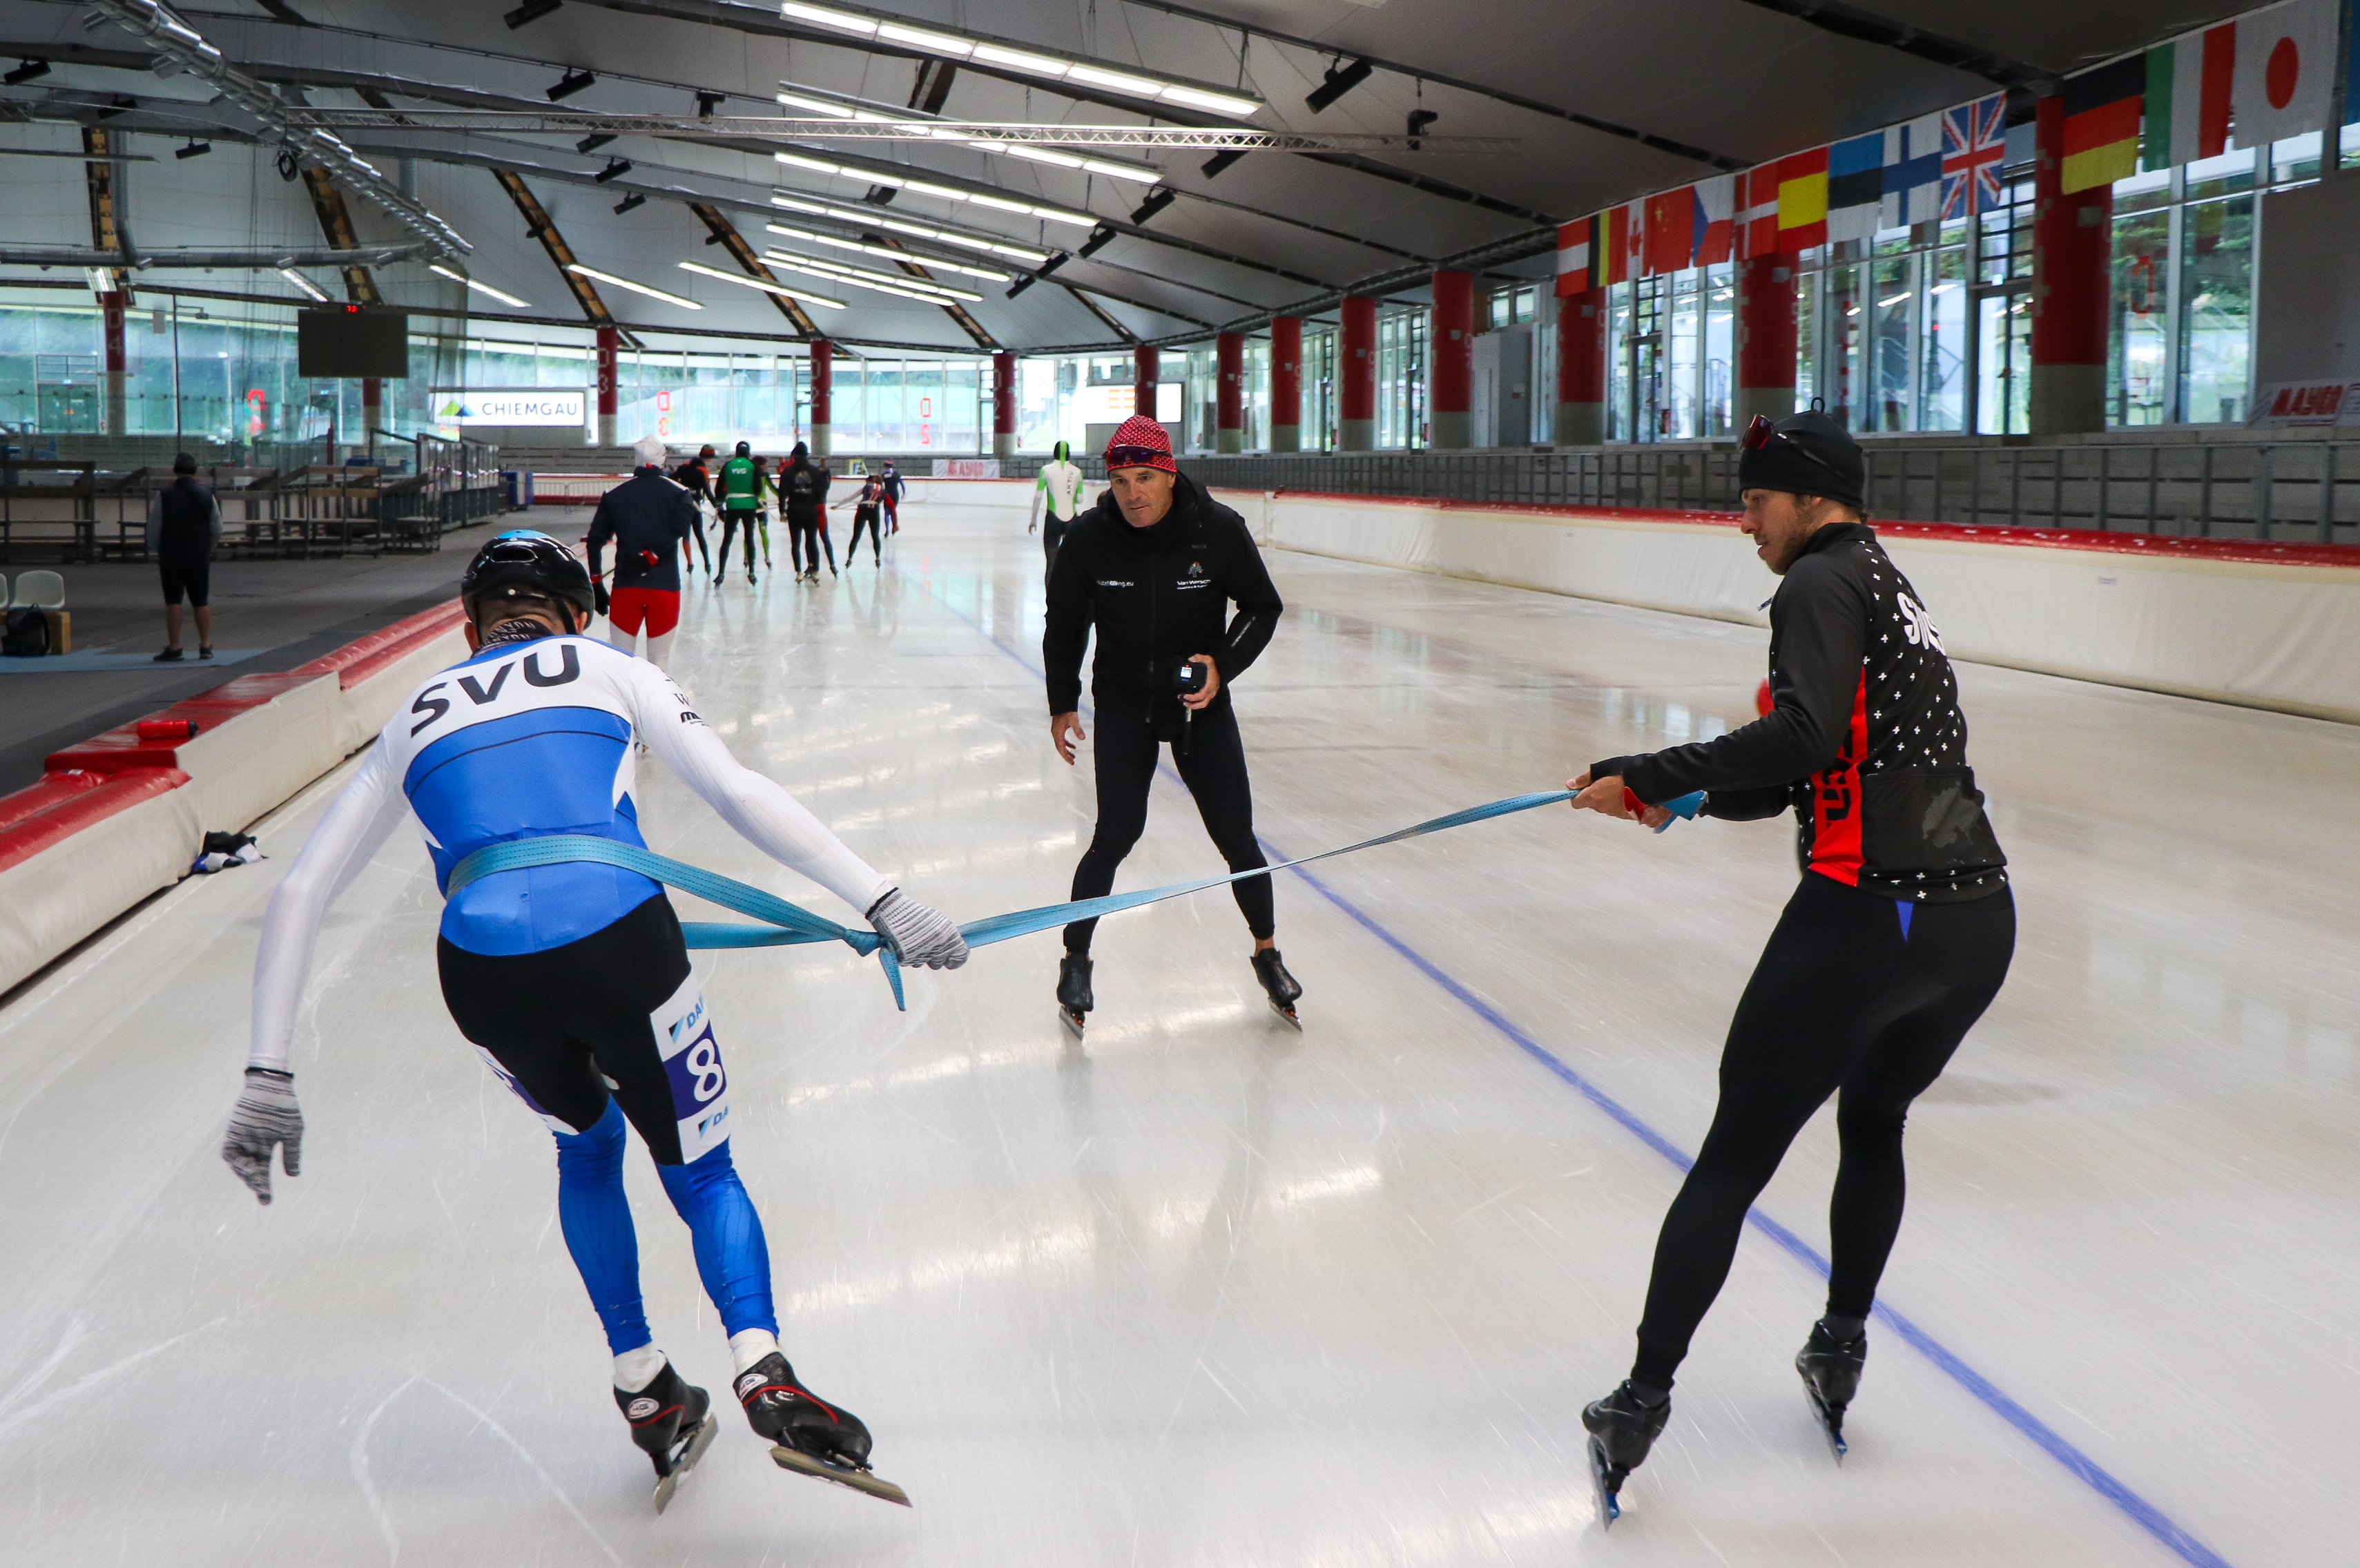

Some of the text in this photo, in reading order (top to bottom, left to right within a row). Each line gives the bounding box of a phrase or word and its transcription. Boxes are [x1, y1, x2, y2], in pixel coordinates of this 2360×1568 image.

[482, 403, 577, 416] CHIEMGAU
[411, 644, 581, 738] SVU
[686, 1038, 724, 1103] 8
